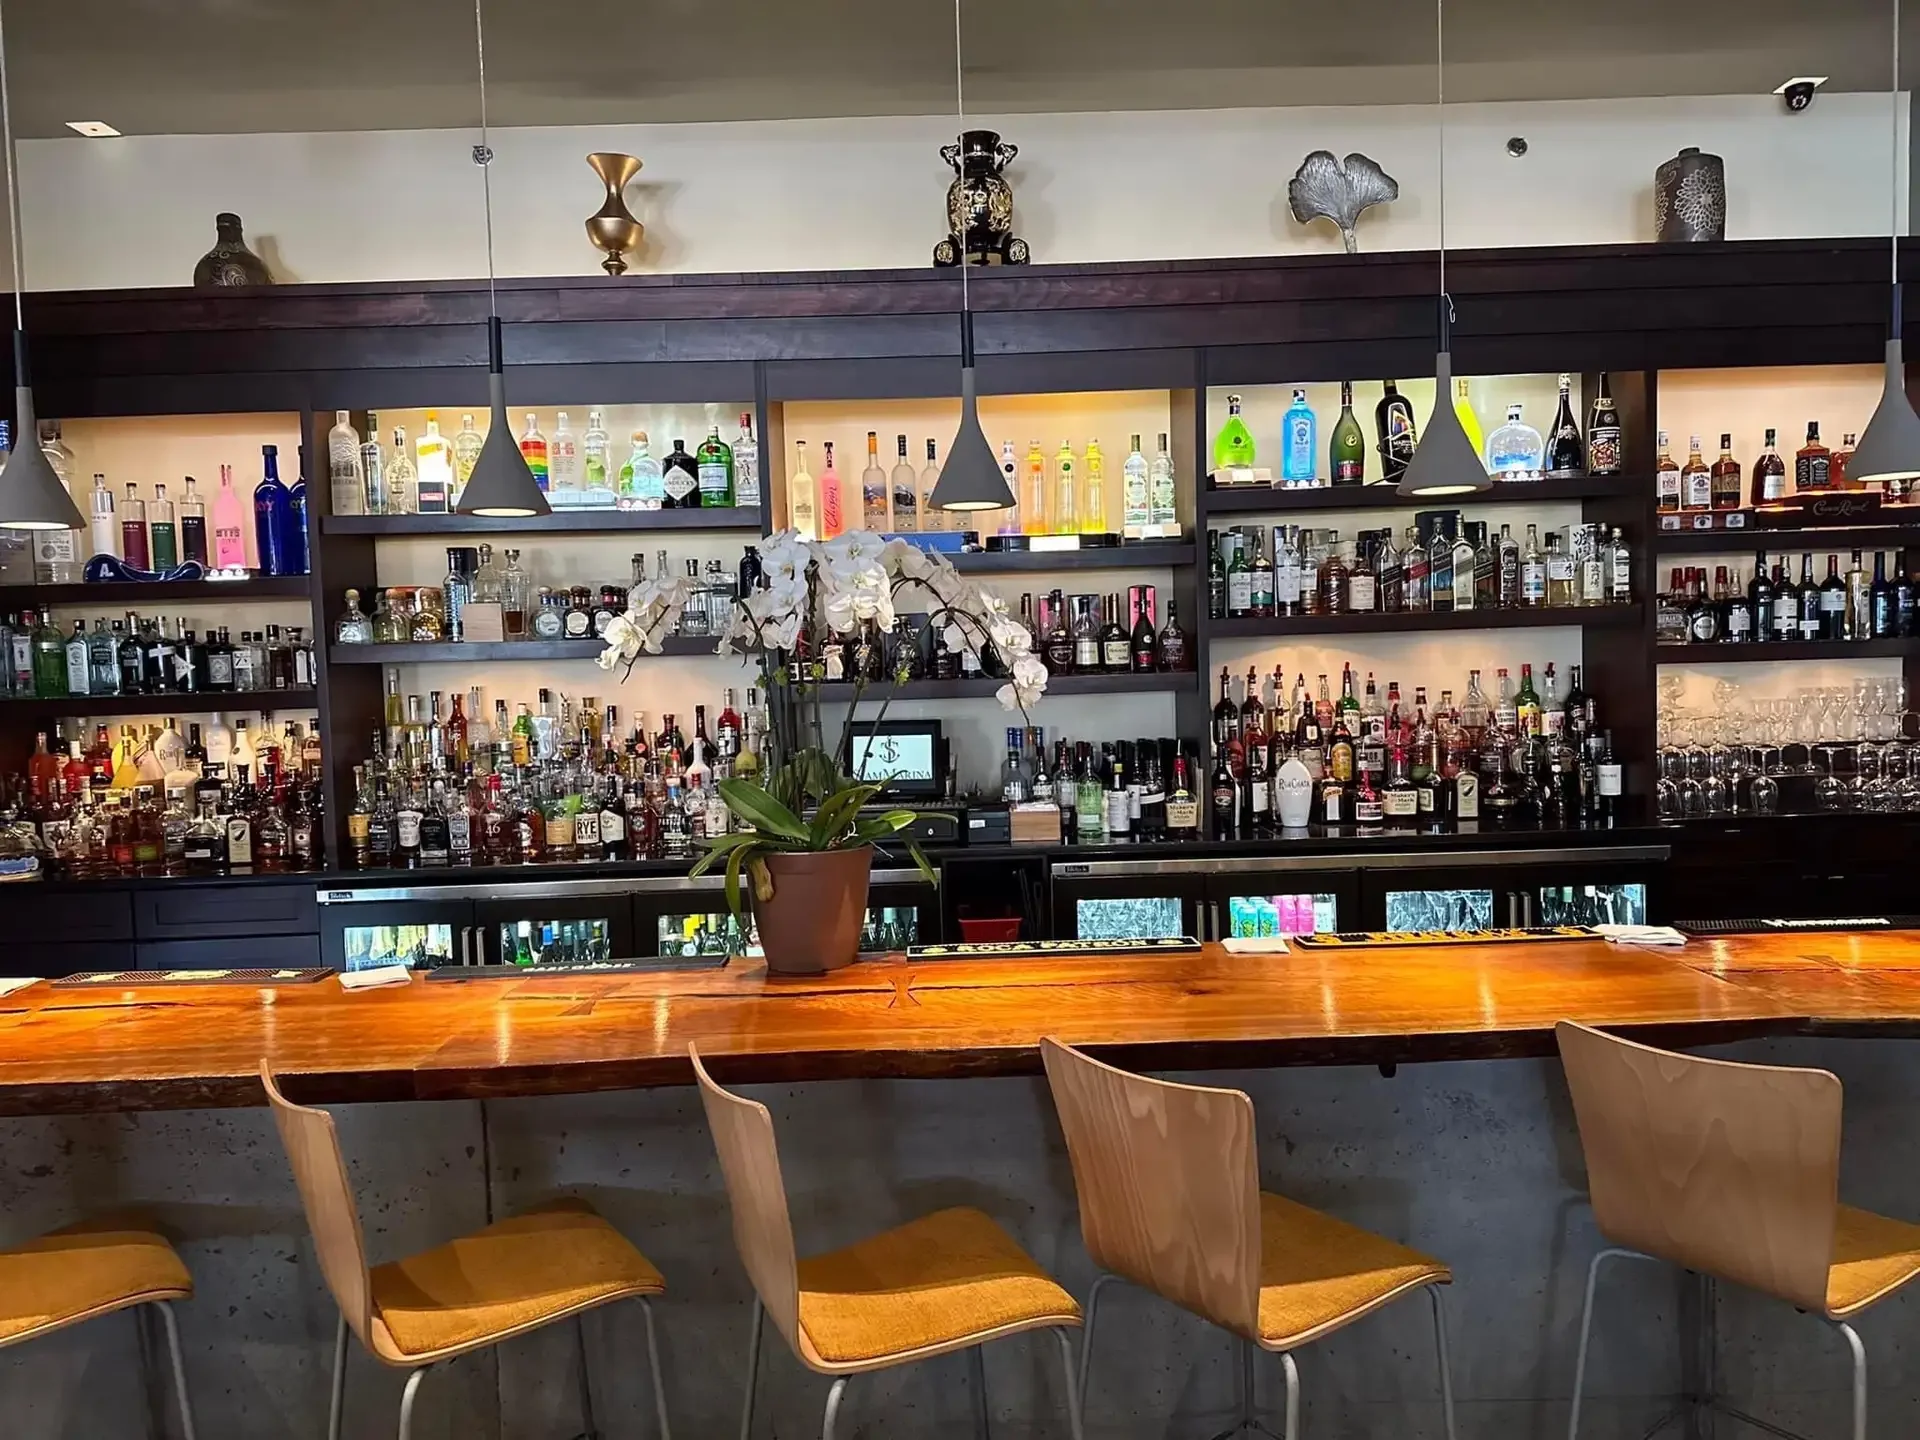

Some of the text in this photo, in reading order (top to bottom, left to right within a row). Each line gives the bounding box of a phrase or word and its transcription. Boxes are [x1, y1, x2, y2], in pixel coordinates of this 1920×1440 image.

[485, 823, 500, 837] 46
[577, 821, 597, 834] RYE
[956, 938, 1149, 952] ROCA PATRÓN
